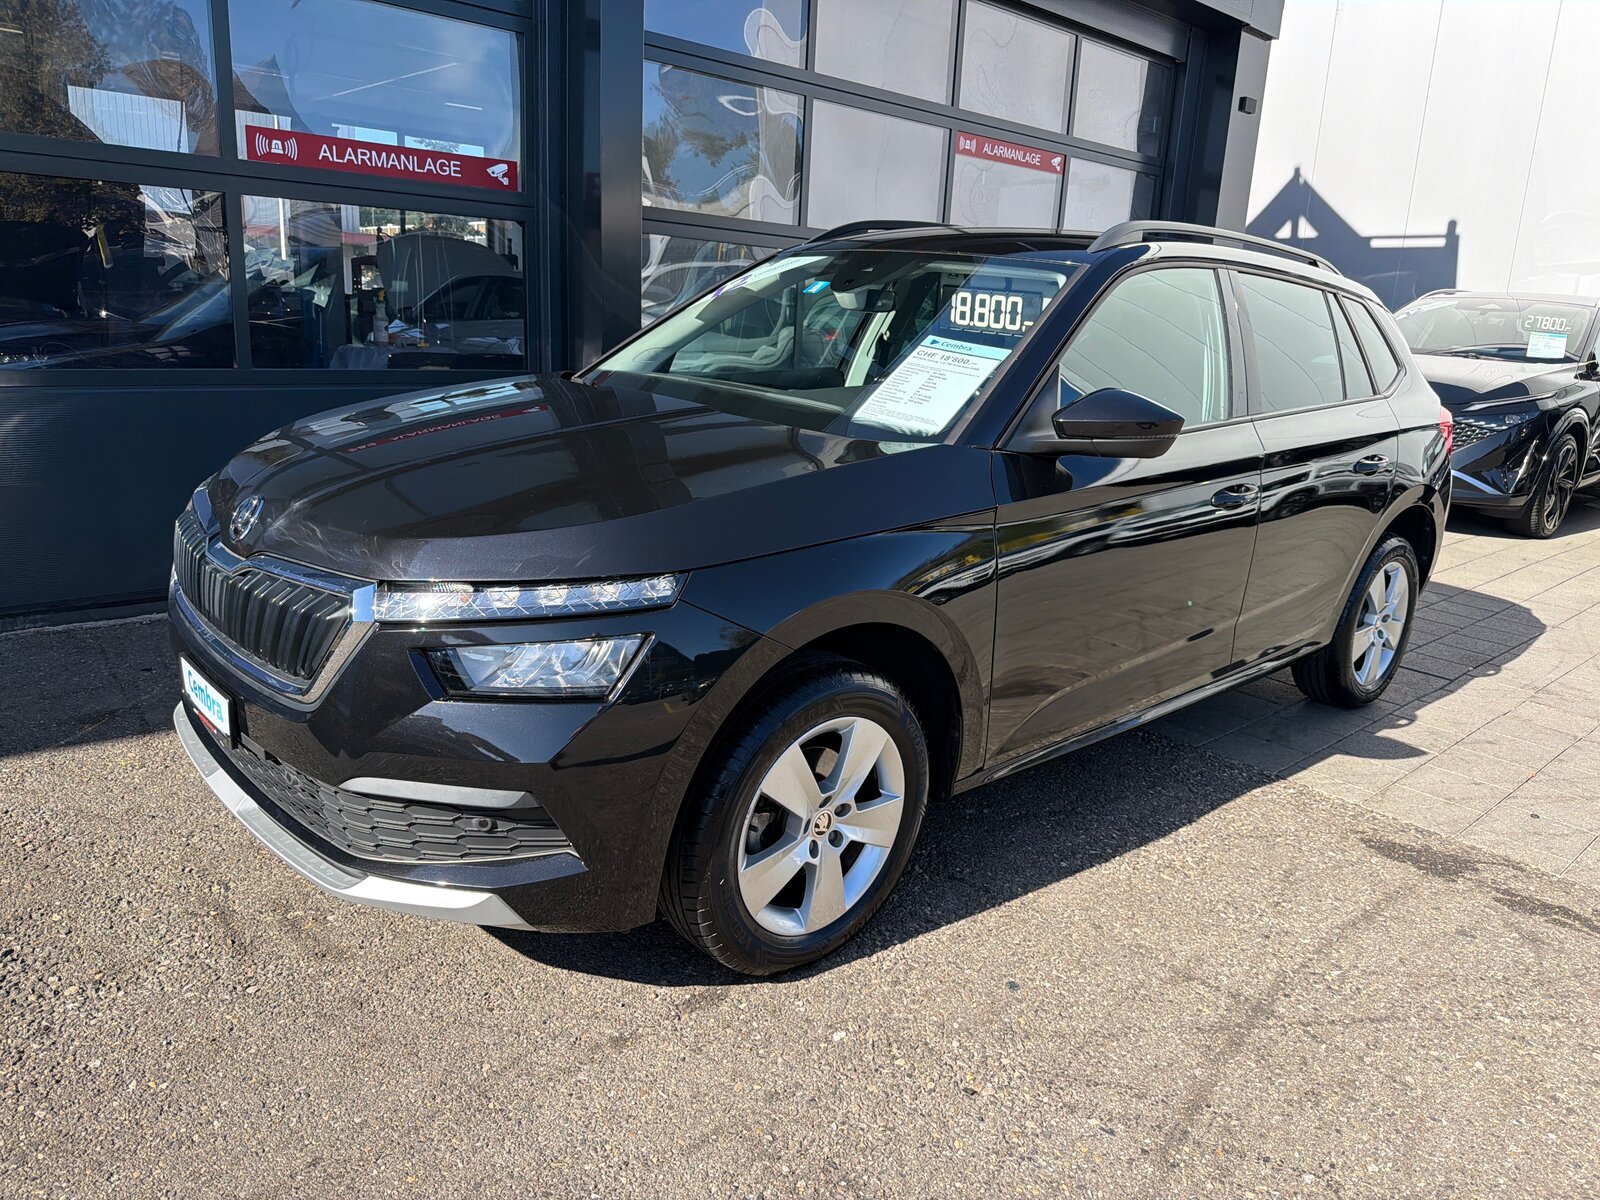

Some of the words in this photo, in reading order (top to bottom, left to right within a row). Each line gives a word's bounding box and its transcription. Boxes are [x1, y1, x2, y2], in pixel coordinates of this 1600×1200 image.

[318, 144, 462, 177] ALARMANLAGE
[983, 142, 1041, 166] ALARMANLAGE
[917, 350, 938, 359] CHF
[941, 341, 972, 352] Cembra
[188, 669, 224, 722] Cembra
